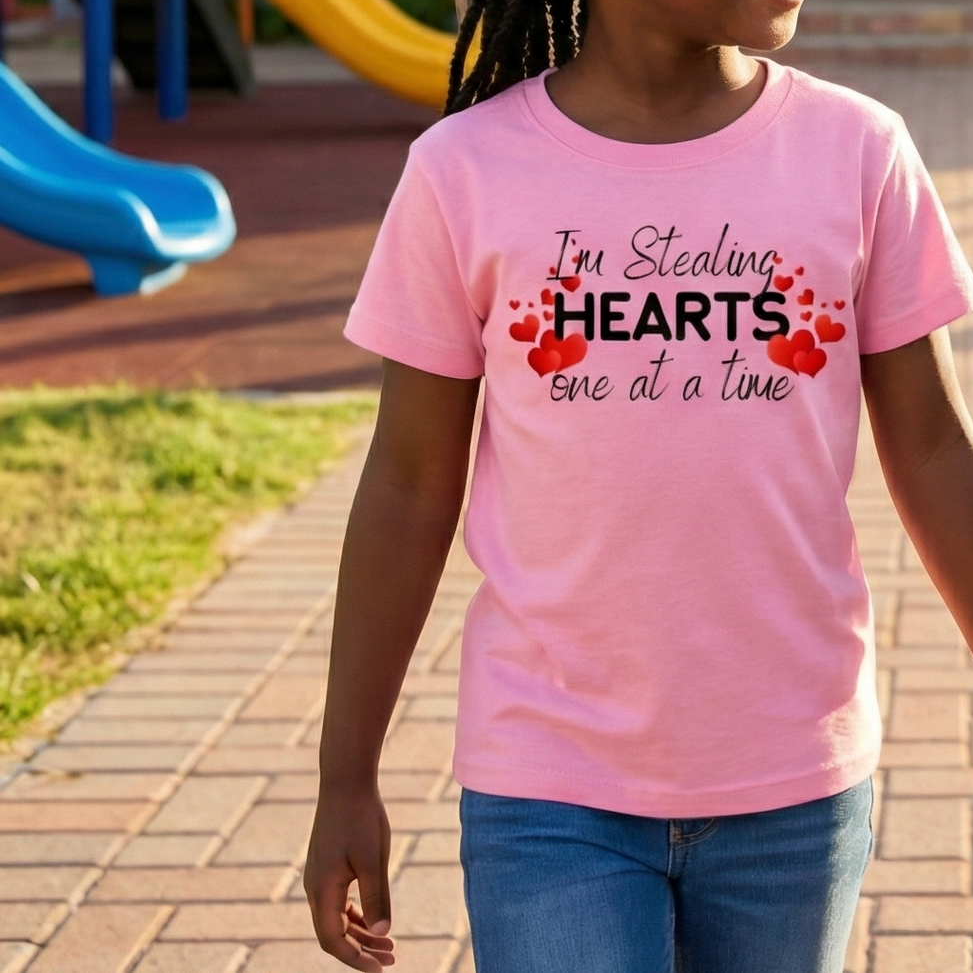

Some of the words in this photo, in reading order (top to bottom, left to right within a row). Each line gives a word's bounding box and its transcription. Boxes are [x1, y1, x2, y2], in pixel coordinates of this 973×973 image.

[546, 230, 604, 281] I'm
[623, 223, 779, 300] Stealing
[554, 292, 790, 342] HEARTS
[550, 373, 614, 402] one
[629, 349, 674, 402] at
[683, 373, 703, 402] a
[721, 348, 795, 402] time
